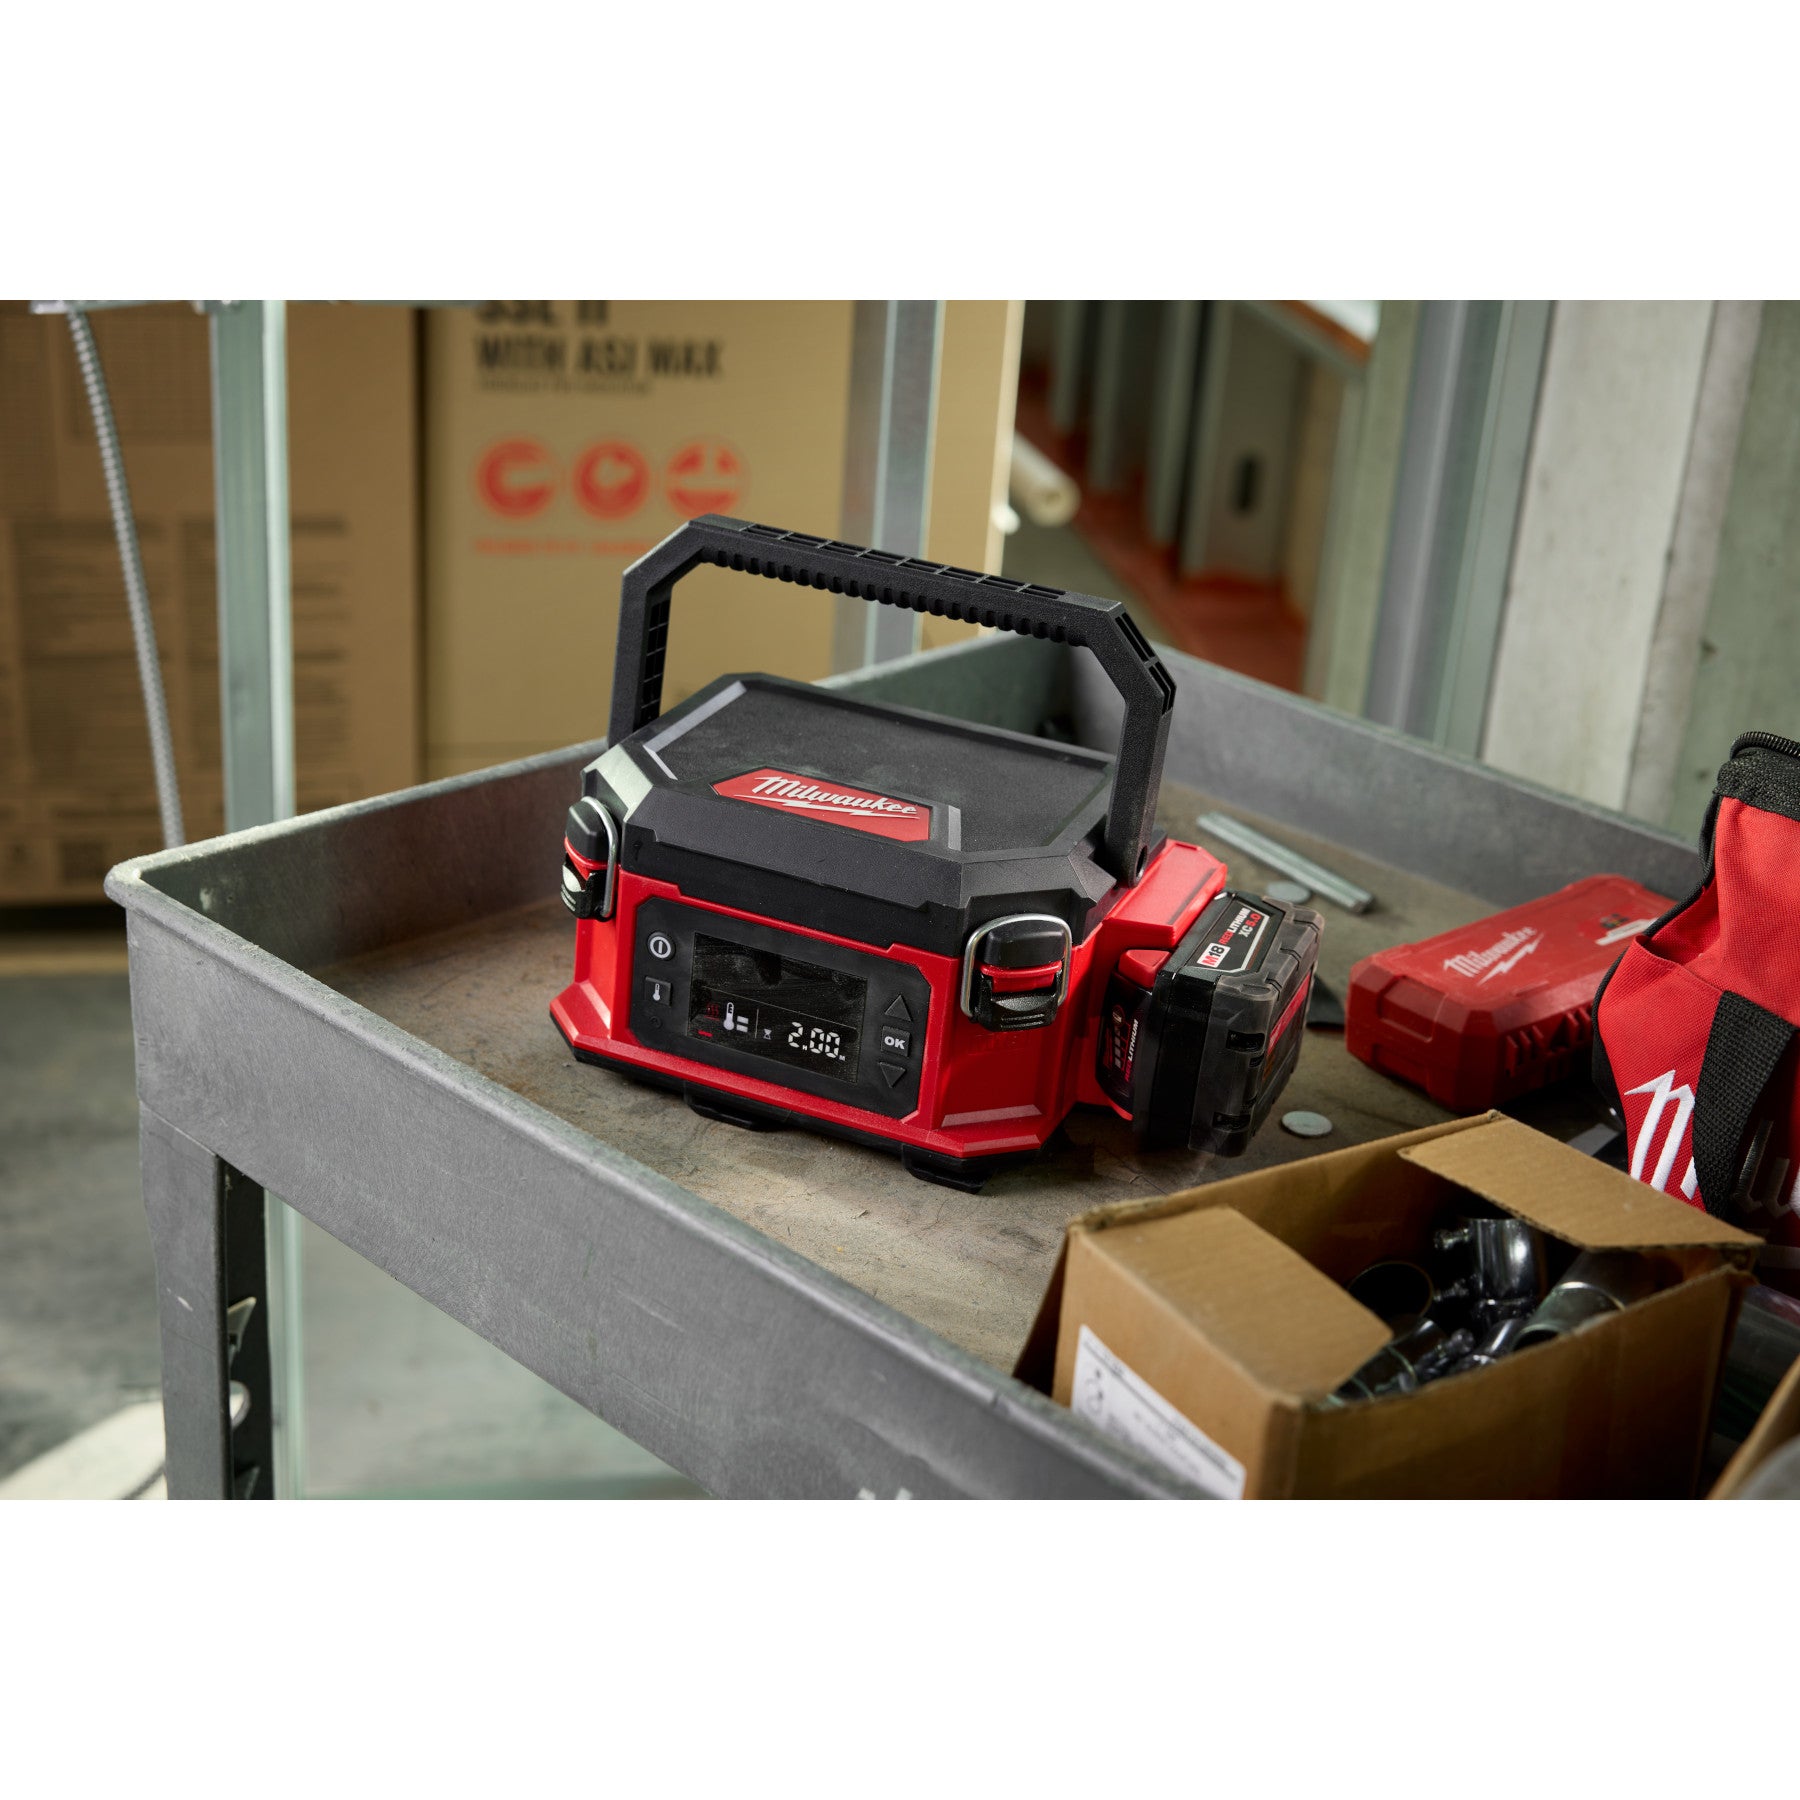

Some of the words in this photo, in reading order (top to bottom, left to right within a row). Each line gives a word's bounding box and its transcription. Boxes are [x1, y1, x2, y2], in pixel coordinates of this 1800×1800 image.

[752, 776, 918, 815] Milwaukee
[1200, 945, 1226, 967] M18
[1218, 907, 1251, 946] REDLITHIUM
[1442, 926, 1537, 978] Milwaukee
[884, 1035, 906, 1050] OK
